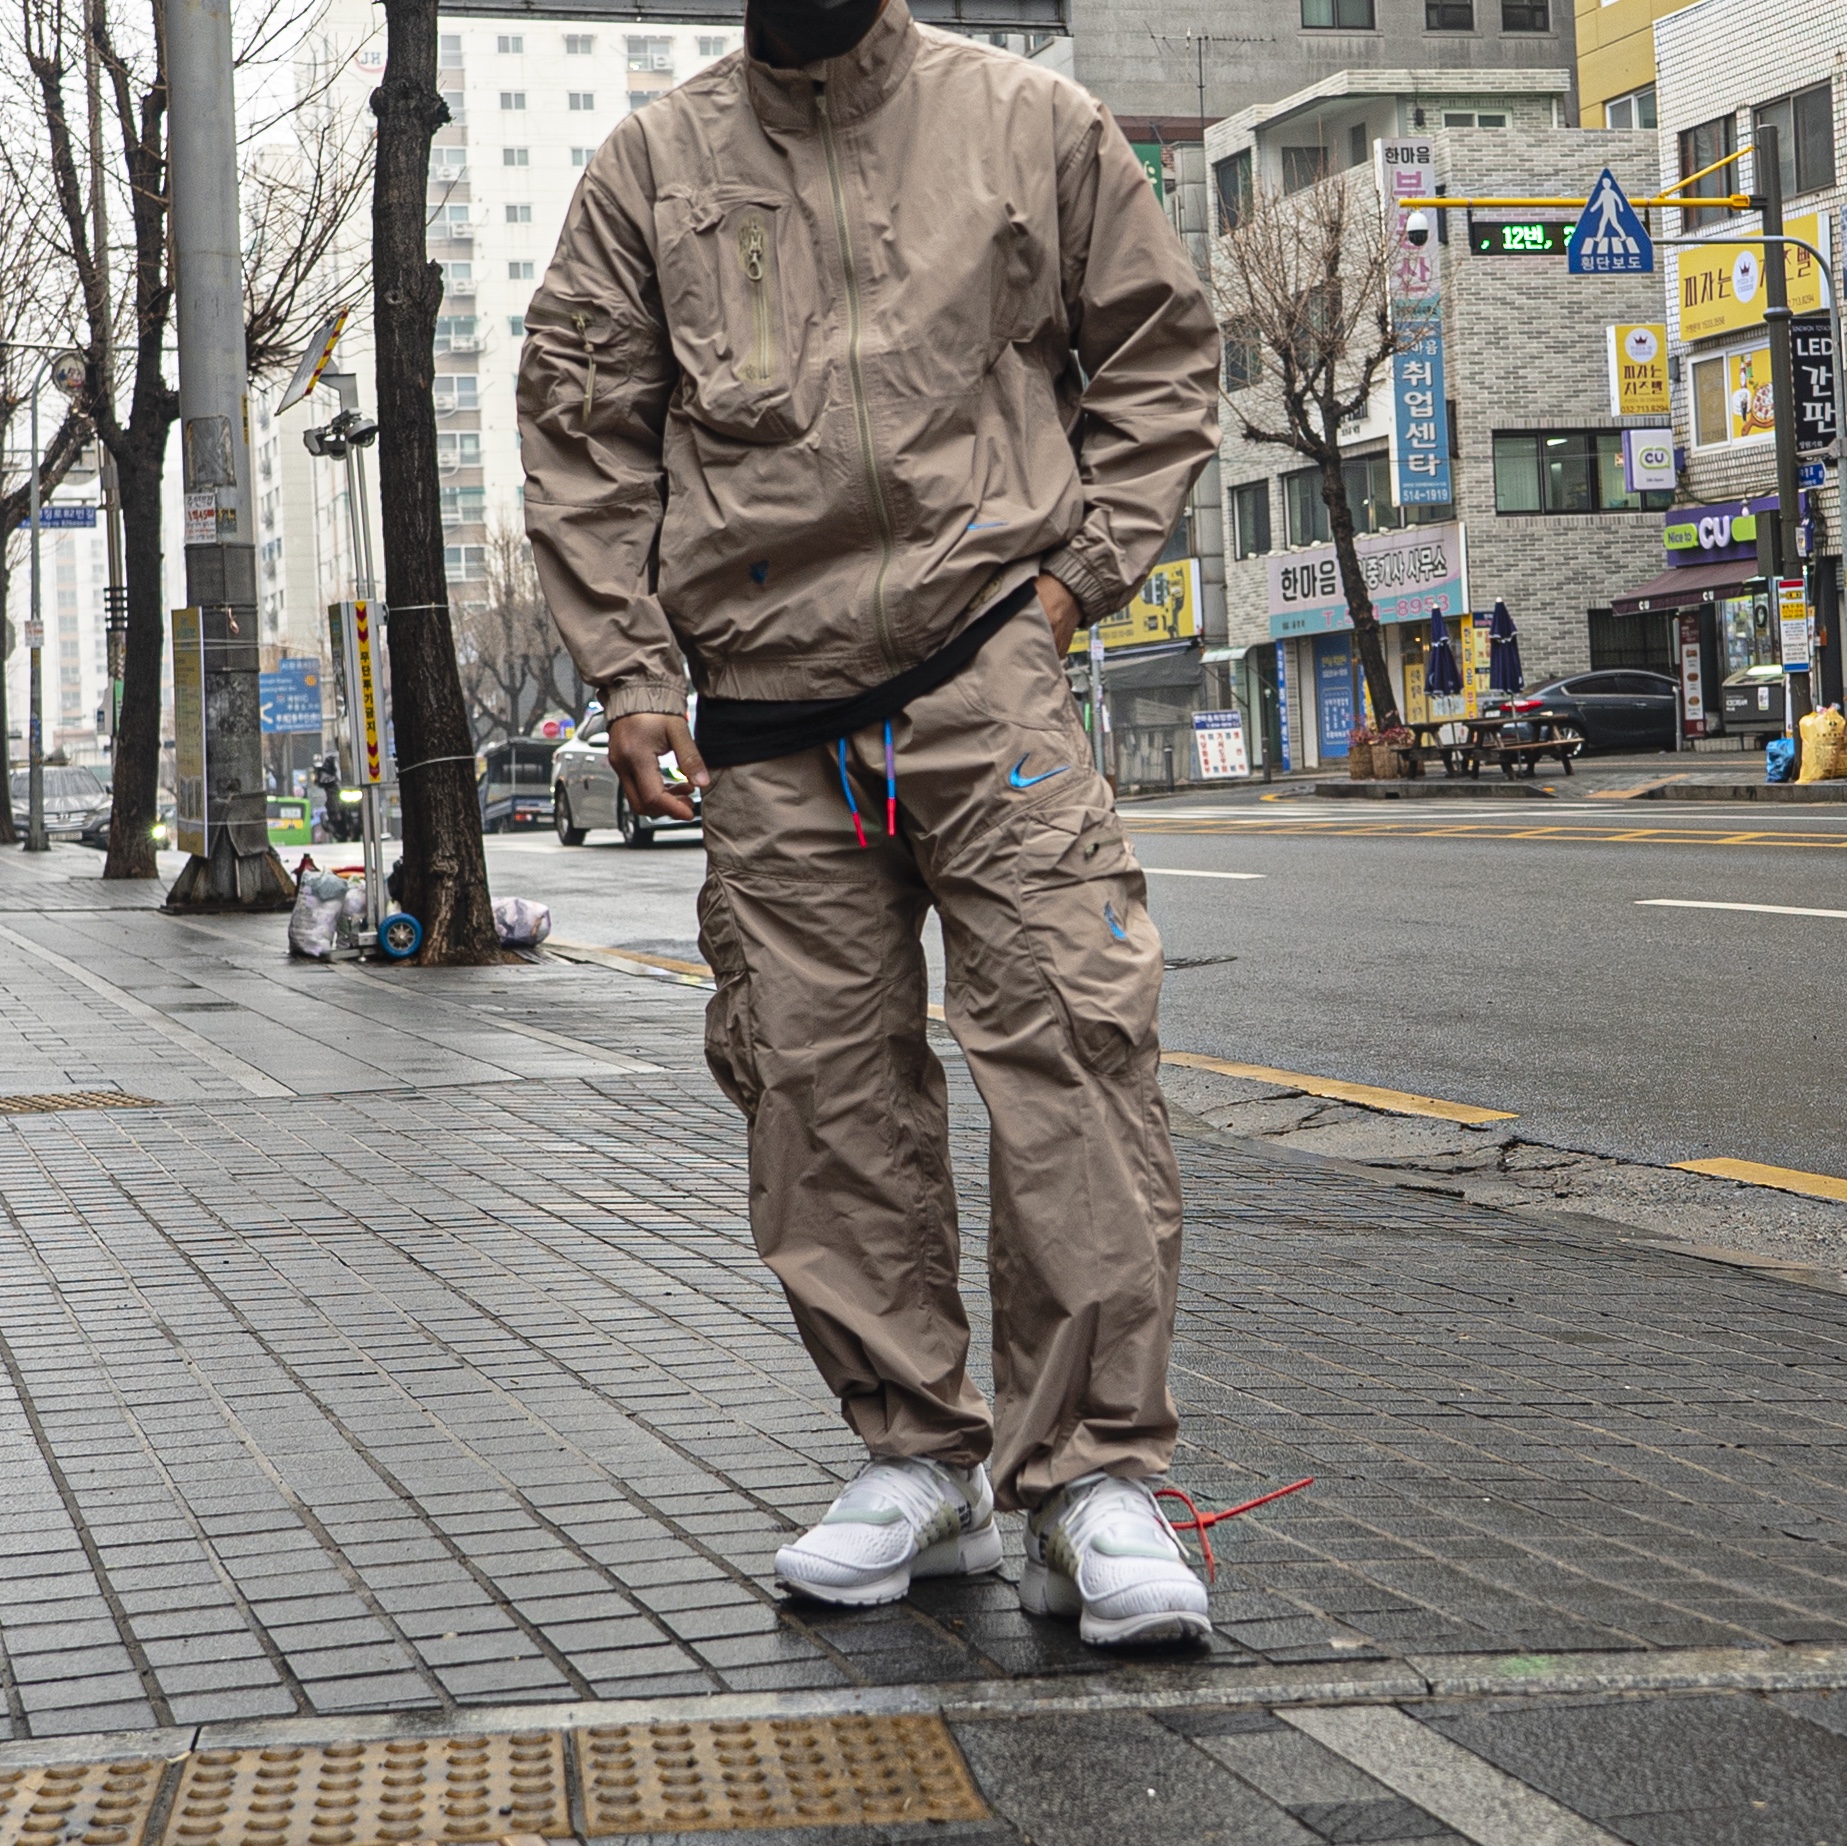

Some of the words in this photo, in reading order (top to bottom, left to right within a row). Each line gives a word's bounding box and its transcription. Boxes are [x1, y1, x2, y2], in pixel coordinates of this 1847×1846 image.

[1385, 146, 1430, 165] 한마음
[1580, 255, 1643, 271] 횡단보도
[1684, 267, 1732, 308] 피자는
[1797, 337, 1834, 357] LED
[1624, 365, 1662, 379] 피자는
[1800, 365, 1837, 434] 간판
[1402, 361, 1442, 478] 취업센타
[1645, 452, 1664, 464] CU
[1403, 489, 1448, 501] 514-1919
[1668, 532, 1682, 544] Nice
[1683, 531, 1692, 543] to
[1699, 515, 1731, 550] CU
[1281, 559, 1336, 602] 한마음
[1408, 546, 1448, 583] 사무소
[1638, 600, 1650, 611] CU
[1702, 591, 1715, 602] CU
[359, 651, 377, 732] 무단투기금지
